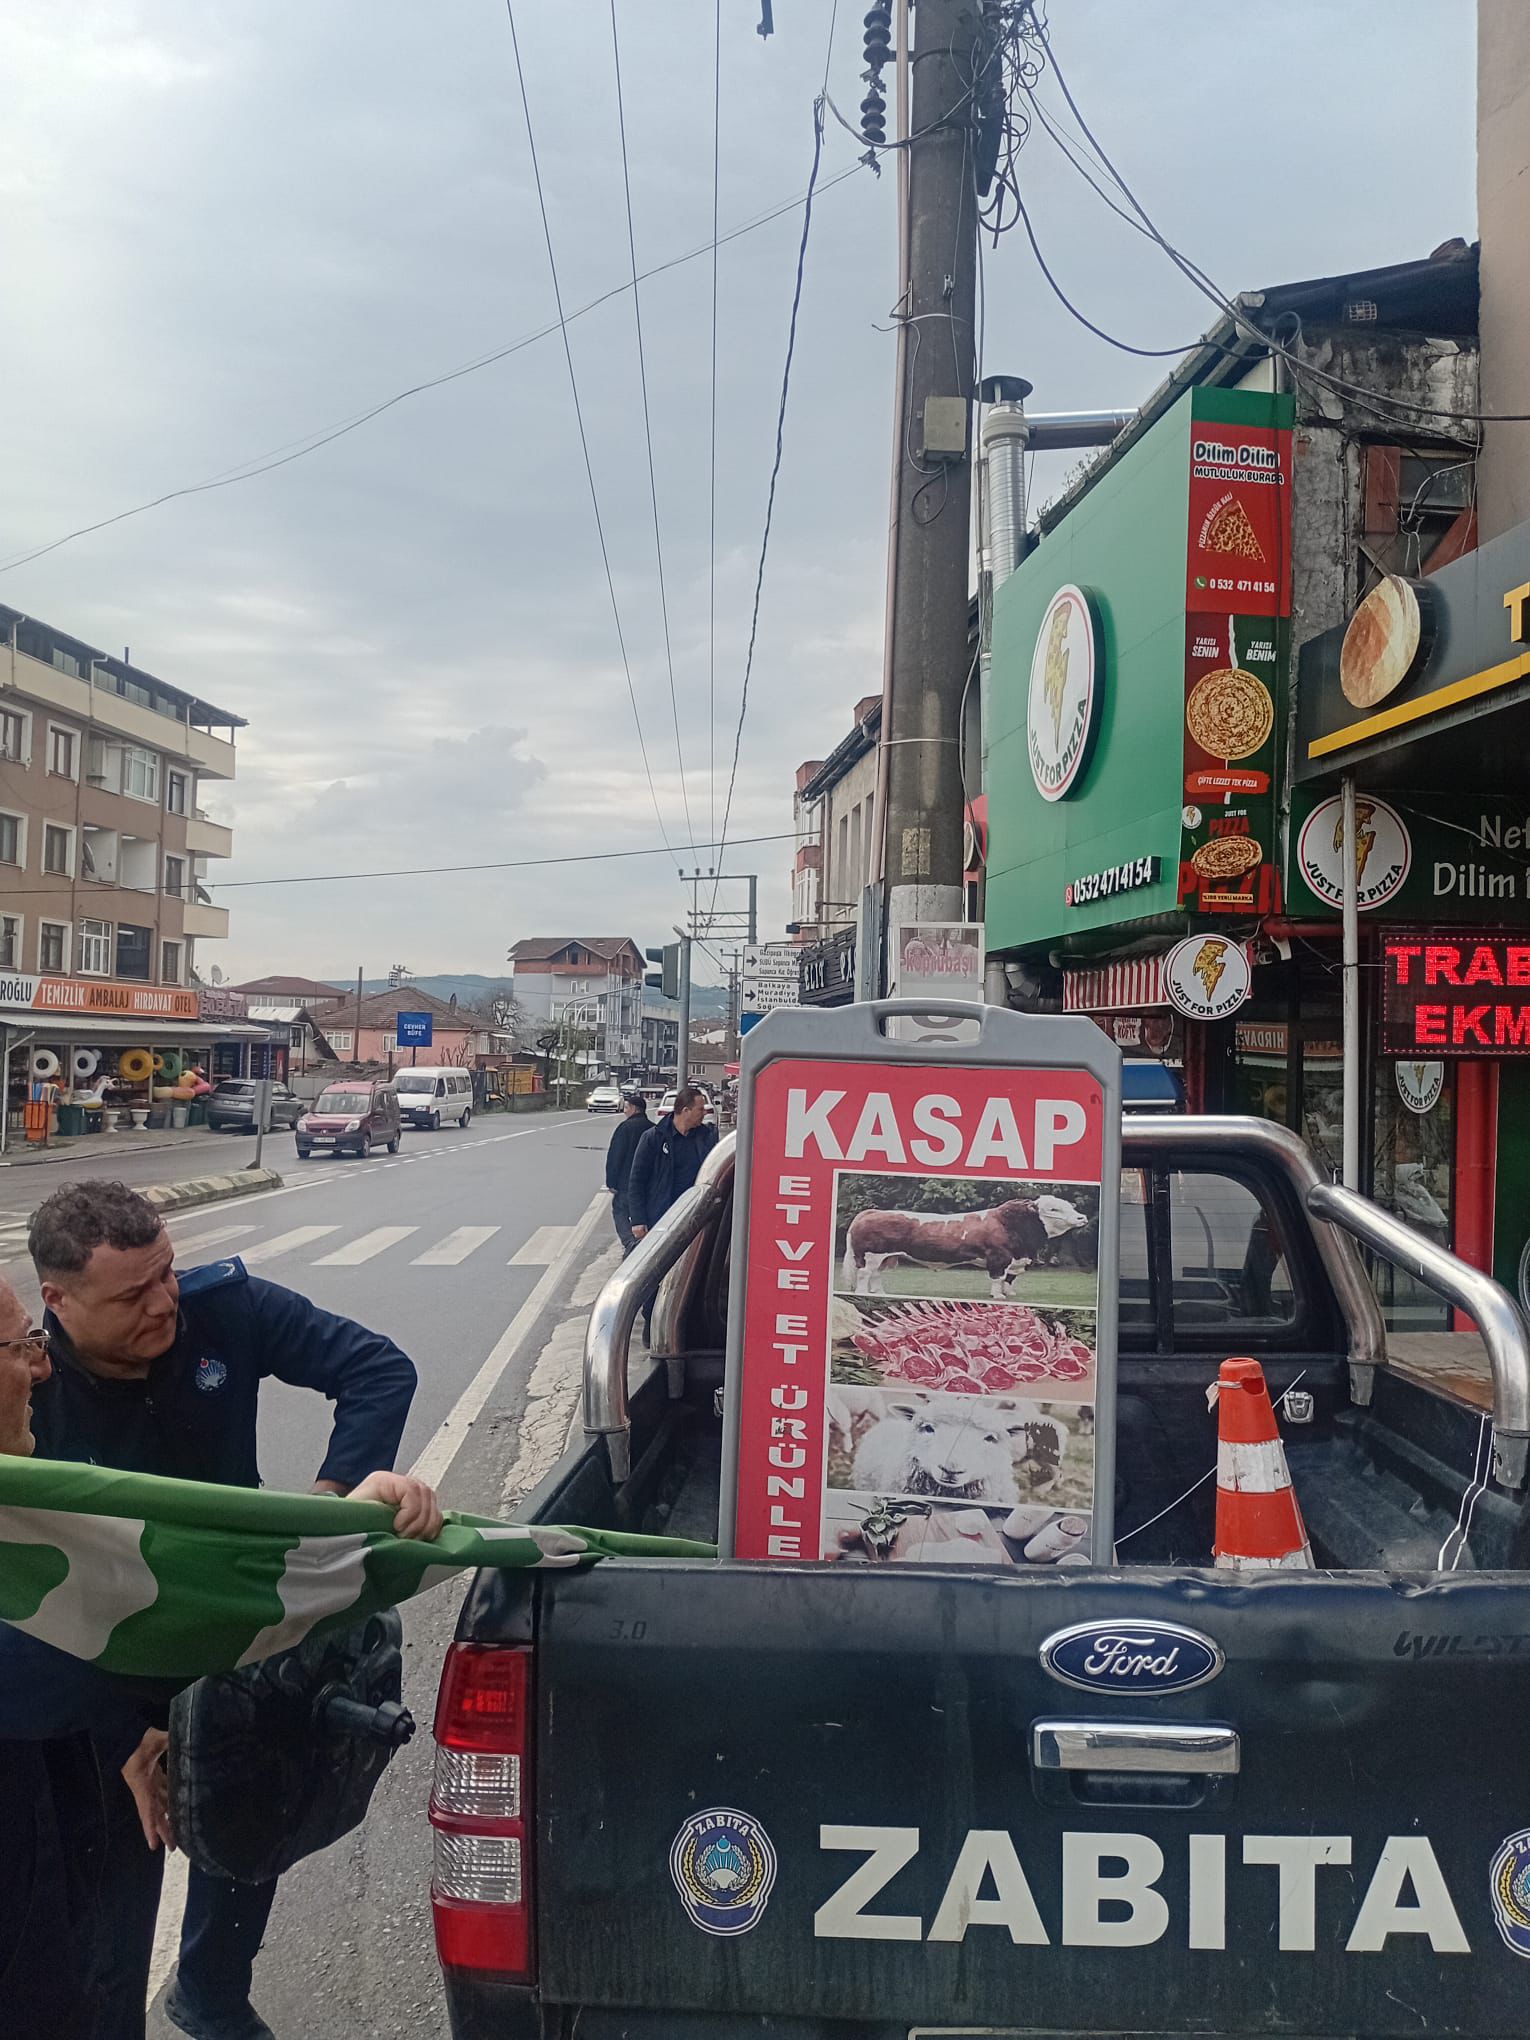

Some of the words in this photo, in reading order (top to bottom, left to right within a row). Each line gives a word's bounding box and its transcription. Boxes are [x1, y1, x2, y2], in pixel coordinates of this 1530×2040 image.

[1194, 441, 1236, 465] Dilim
[1238, 446, 1280, 469] Dilim
[1194, 465, 1245, 481] MUTLULUK
[1246, 470, 1284, 486] BURADA
[1209, 578, 1216, 589] 0
[1217, 579, 1233, 590] 532
[1237, 580, 1252, 591] 471
[1253, 581, 1262, 592] 41
[1264, 582, 1275, 593] 54
[1031, 728, 1046, 778] JUST
[1044, 762, 1062, 786] FOR
[1061, 698, 1087, 774] PIZZA
[1306, 860, 1336, 895] JUST
[1334, 888, 1366, 902] FR
[1366, 864, 1403, 901] PIZZA
[1433, 862, 1515, 898] Dilim
[0, 977, 32, 1002] ROĞLU
[41, 982, 85, 1006] TEMİZLİK
[89, 987, 129, 1008] AMBALAJ
[134, 992, 172, 1012] HIRDAVAT
[175, 995, 192, 1013] OTEL
[757, 989, 796, 997] Muradiye
[1172, 979, 1192, 1005] JUST
[1190, 1003, 1214, 1015] FOR
[1215, 988, 1244, 1014] PIZZA
[1400, 1076, 1411, 1099] JUST
[1410, 1095, 1423, 1106] FOR
[1423, 1077, 1440, 1104] PIZZA
[785, 1088, 1087, 1171] KASAP
[608, 1619, 647, 1640] 3.0
[1083, 1635, 1180, 1677] Ford
[694, 1815, 751, 1837] ZABITA
[813, 1824, 1472, 1953] ZABITA
